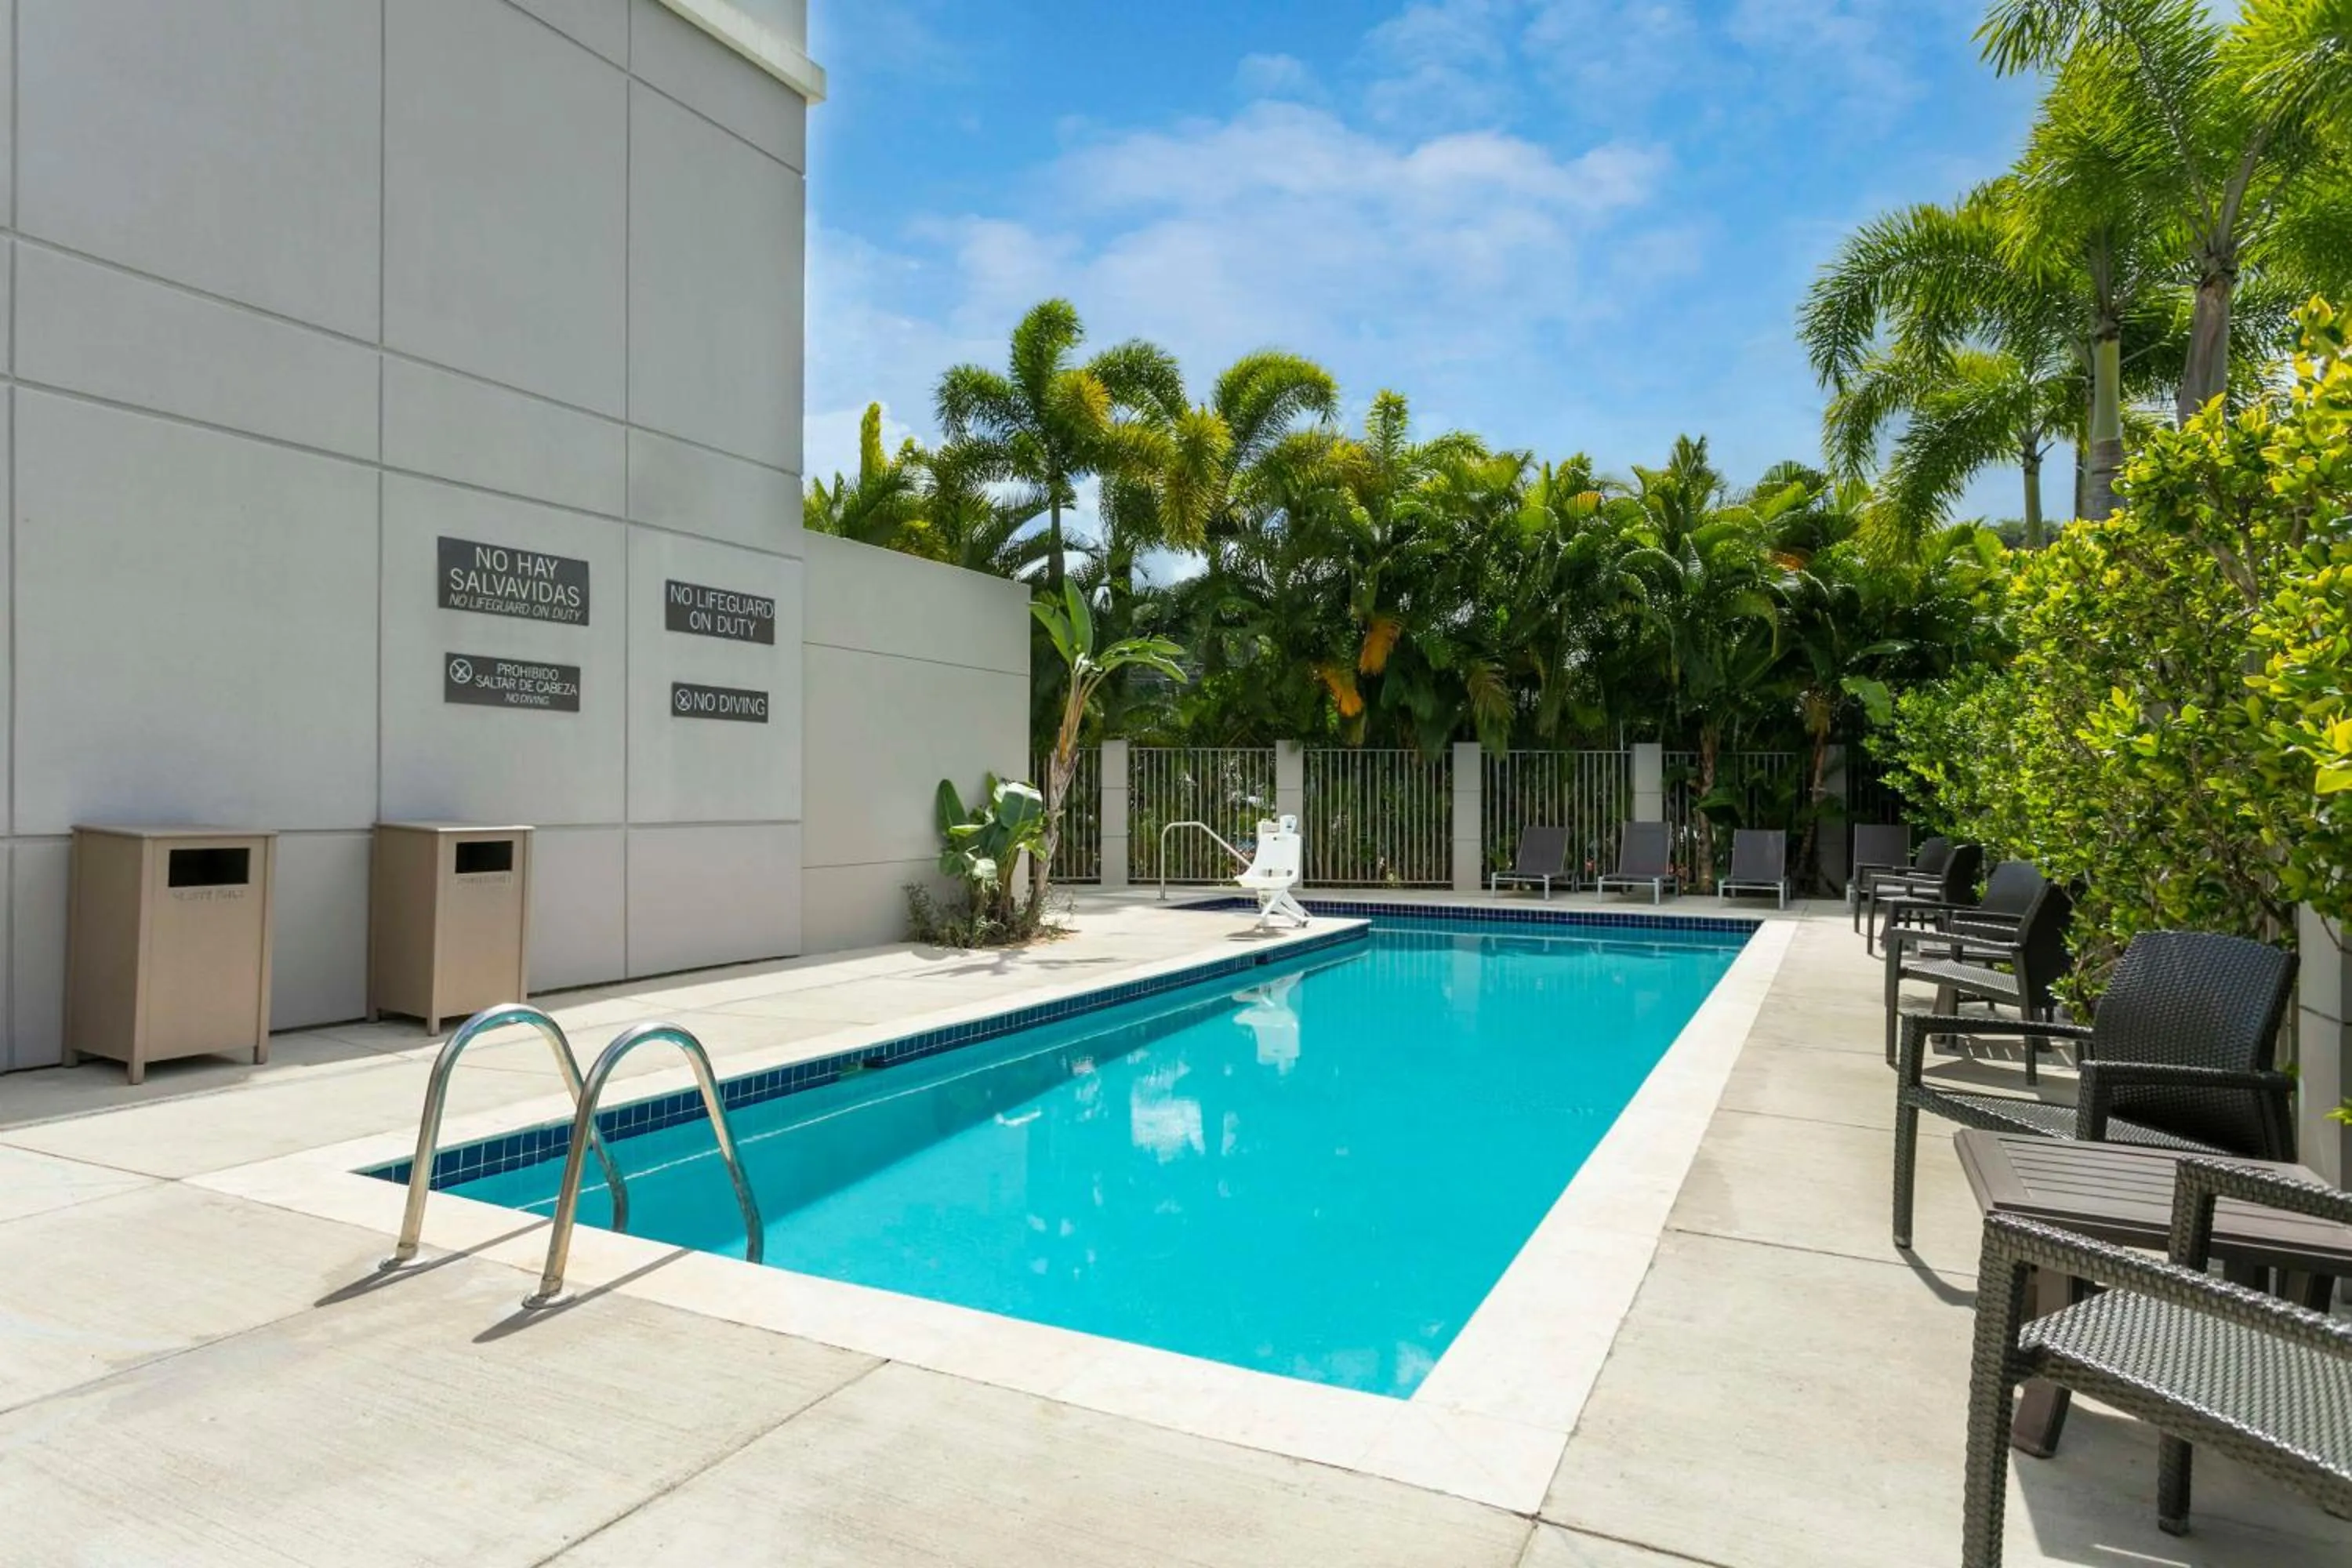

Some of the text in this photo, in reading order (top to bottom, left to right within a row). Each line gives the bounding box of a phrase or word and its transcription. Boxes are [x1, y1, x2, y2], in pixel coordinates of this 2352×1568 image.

[475, 546, 559, 579] NO HAY
[450, 567, 581, 607] SALVAVIDAS
[449, 593, 583, 621] NO LIFEGUARD ON DUTY
[670, 585, 774, 619] NO LIFEGUARD
[689, 611, 757, 637] ON DUTY
[497, 662, 559, 681] PROHIBIDO
[475, 675, 578, 696] SALTAR DE CABEZA
[694, 691, 766, 715] NO DIVING
